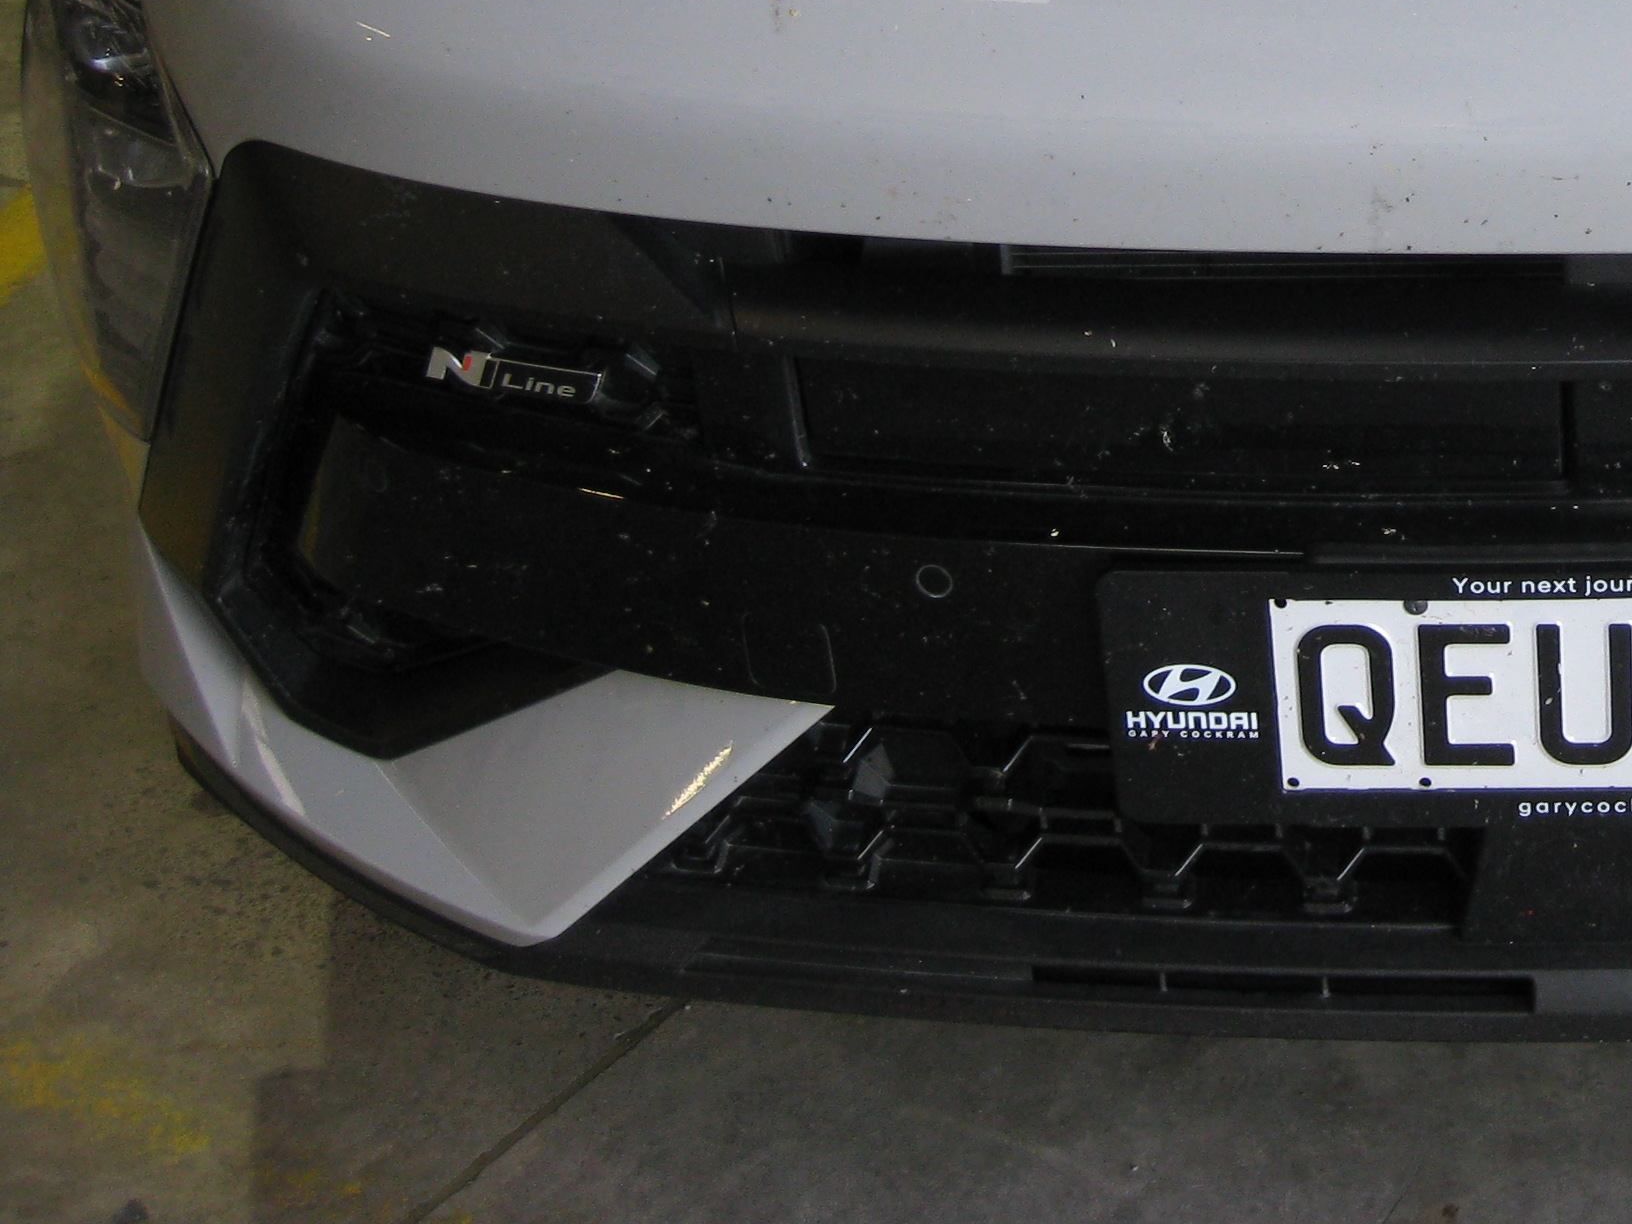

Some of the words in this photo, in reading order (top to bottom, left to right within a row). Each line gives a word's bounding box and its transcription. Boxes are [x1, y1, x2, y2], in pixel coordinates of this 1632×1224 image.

[426, 346, 492, 389] N
[502, 373, 576, 397] Line
[1451, 576, 1511, 594] Your
[1521, 577, 1577, 594] next
[1126, 710, 1259, 730] HYUNDAI
[1128, 729, 1170, 738] GARY
[1180, 730, 1259, 739] COCKRAM
